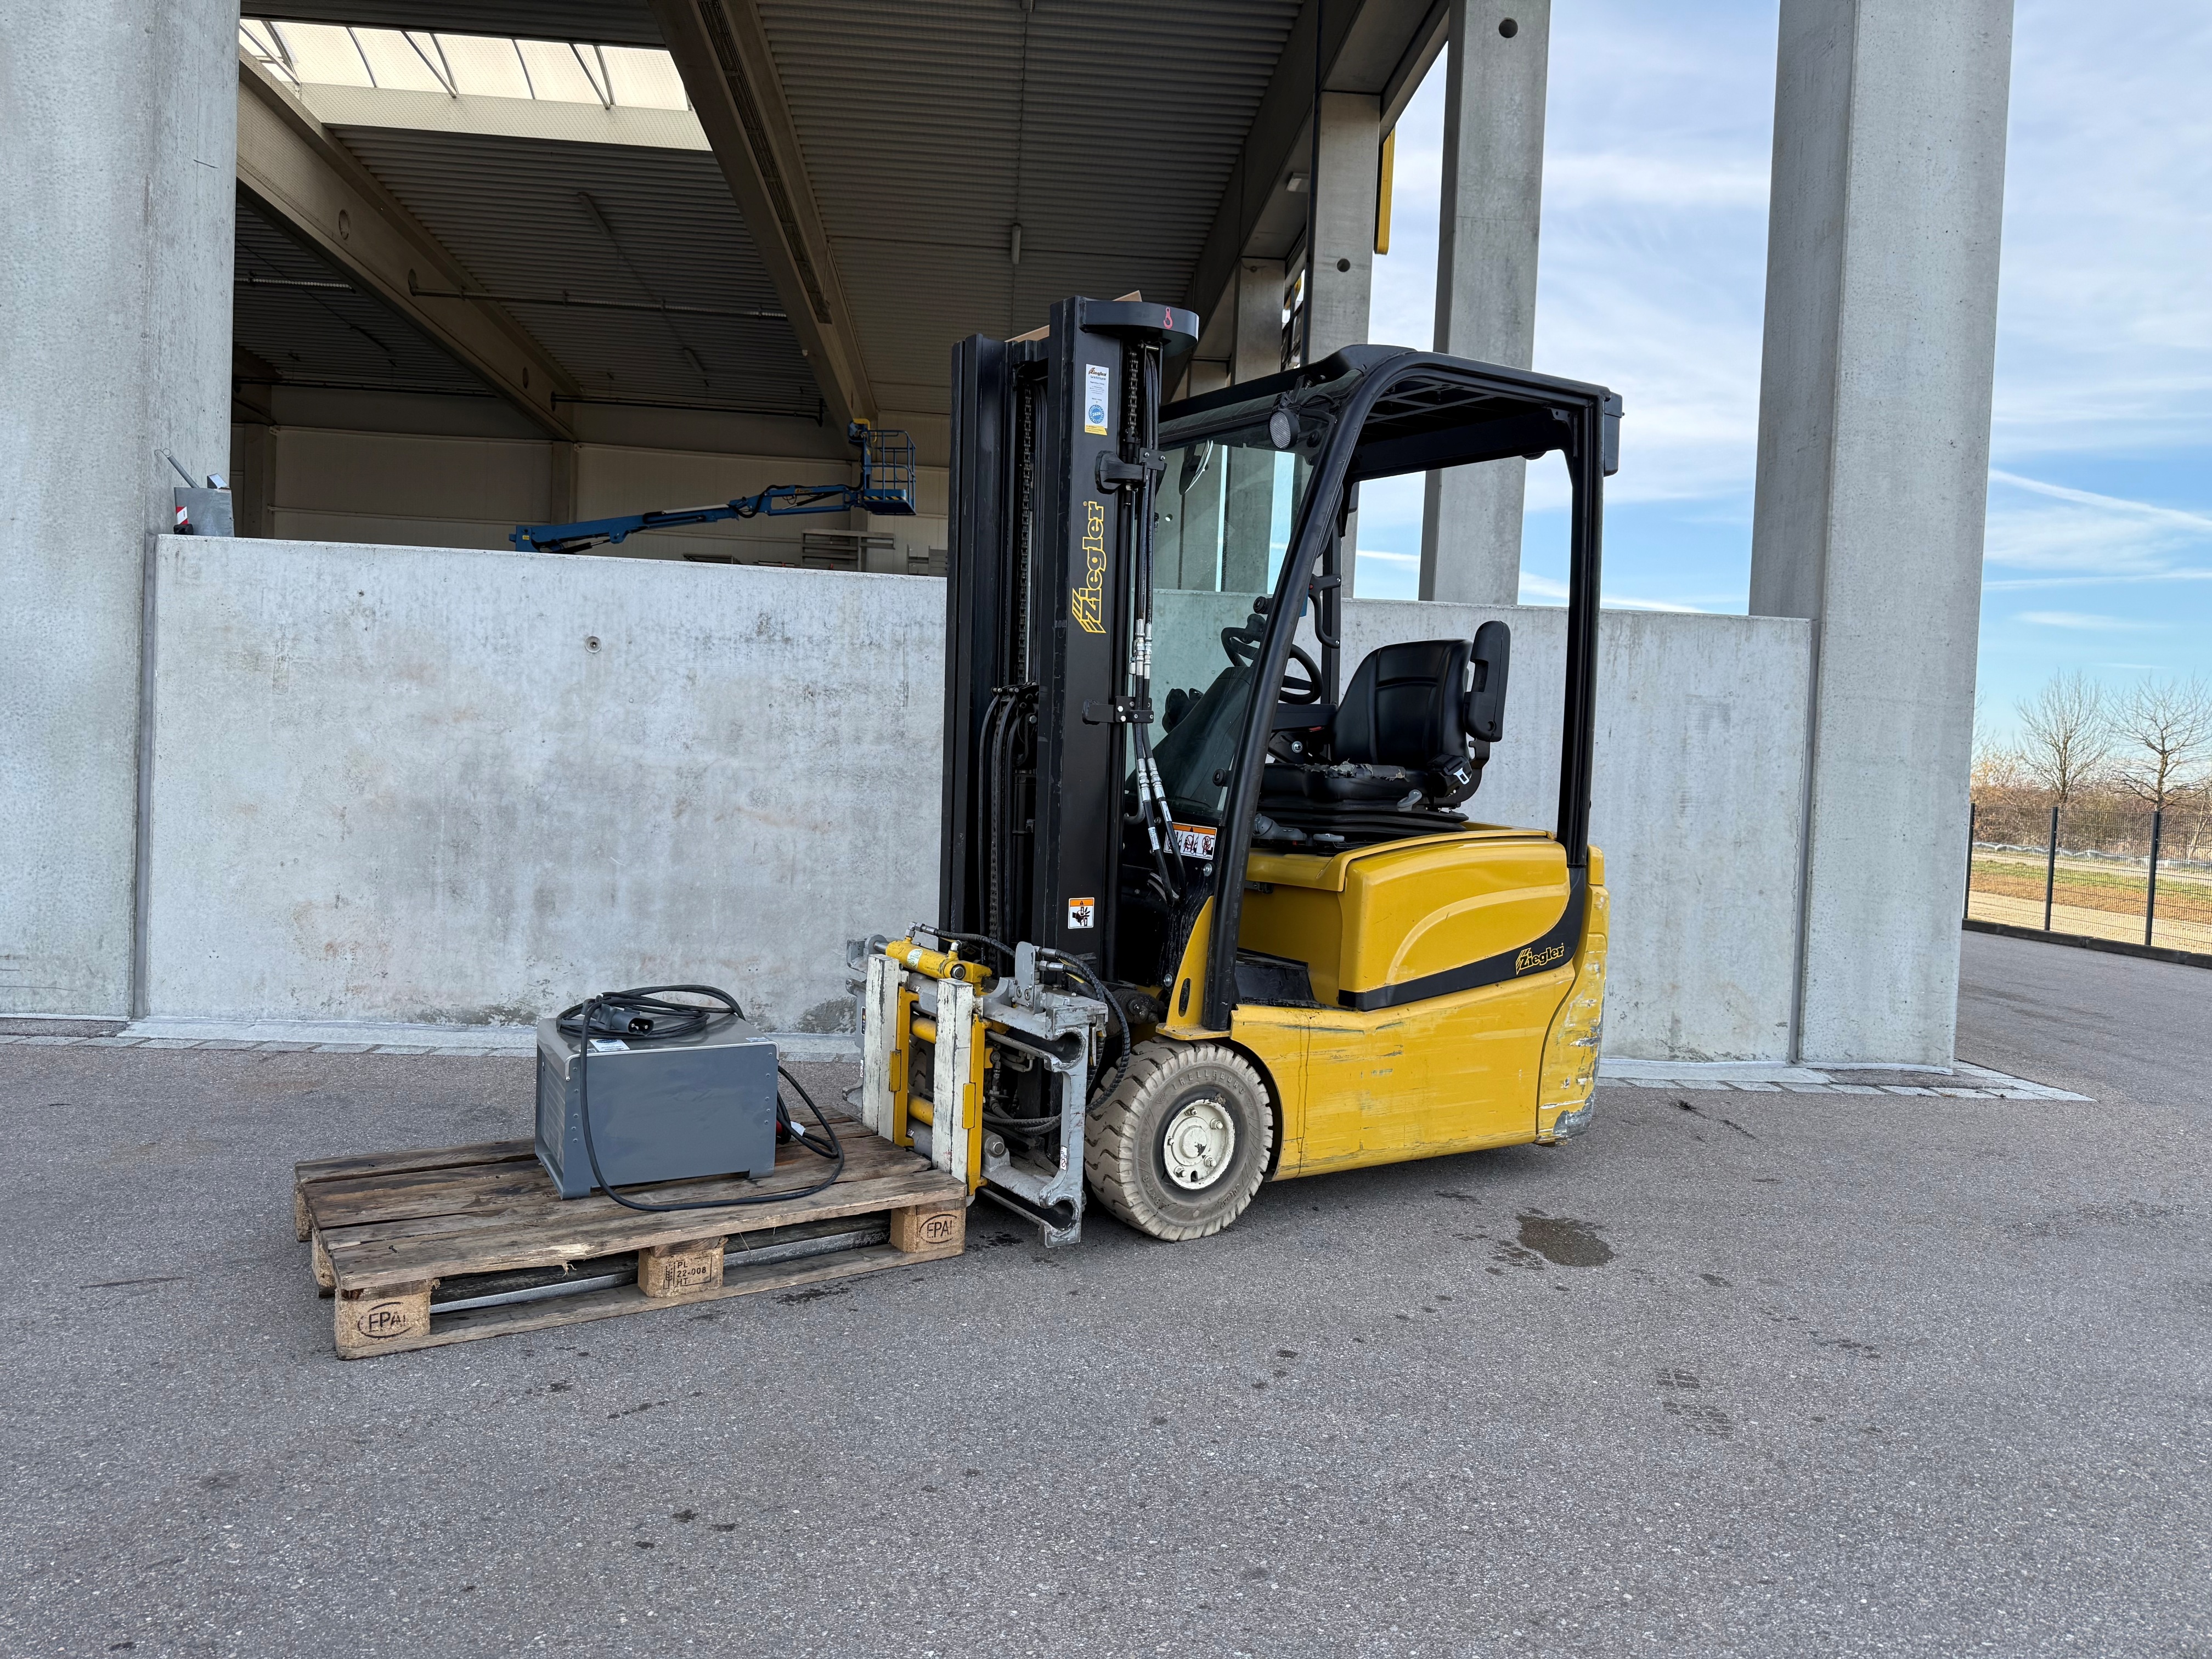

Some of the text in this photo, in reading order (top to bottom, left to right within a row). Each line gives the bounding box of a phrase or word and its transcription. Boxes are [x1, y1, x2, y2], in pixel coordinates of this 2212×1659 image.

[1076, 501, 1107, 627] Ziegler
[1518, 945, 1564, 971] Ziegler
[677, 1266, 707, 1278] 22-008
[677, 1277, 689, 1285] HT
